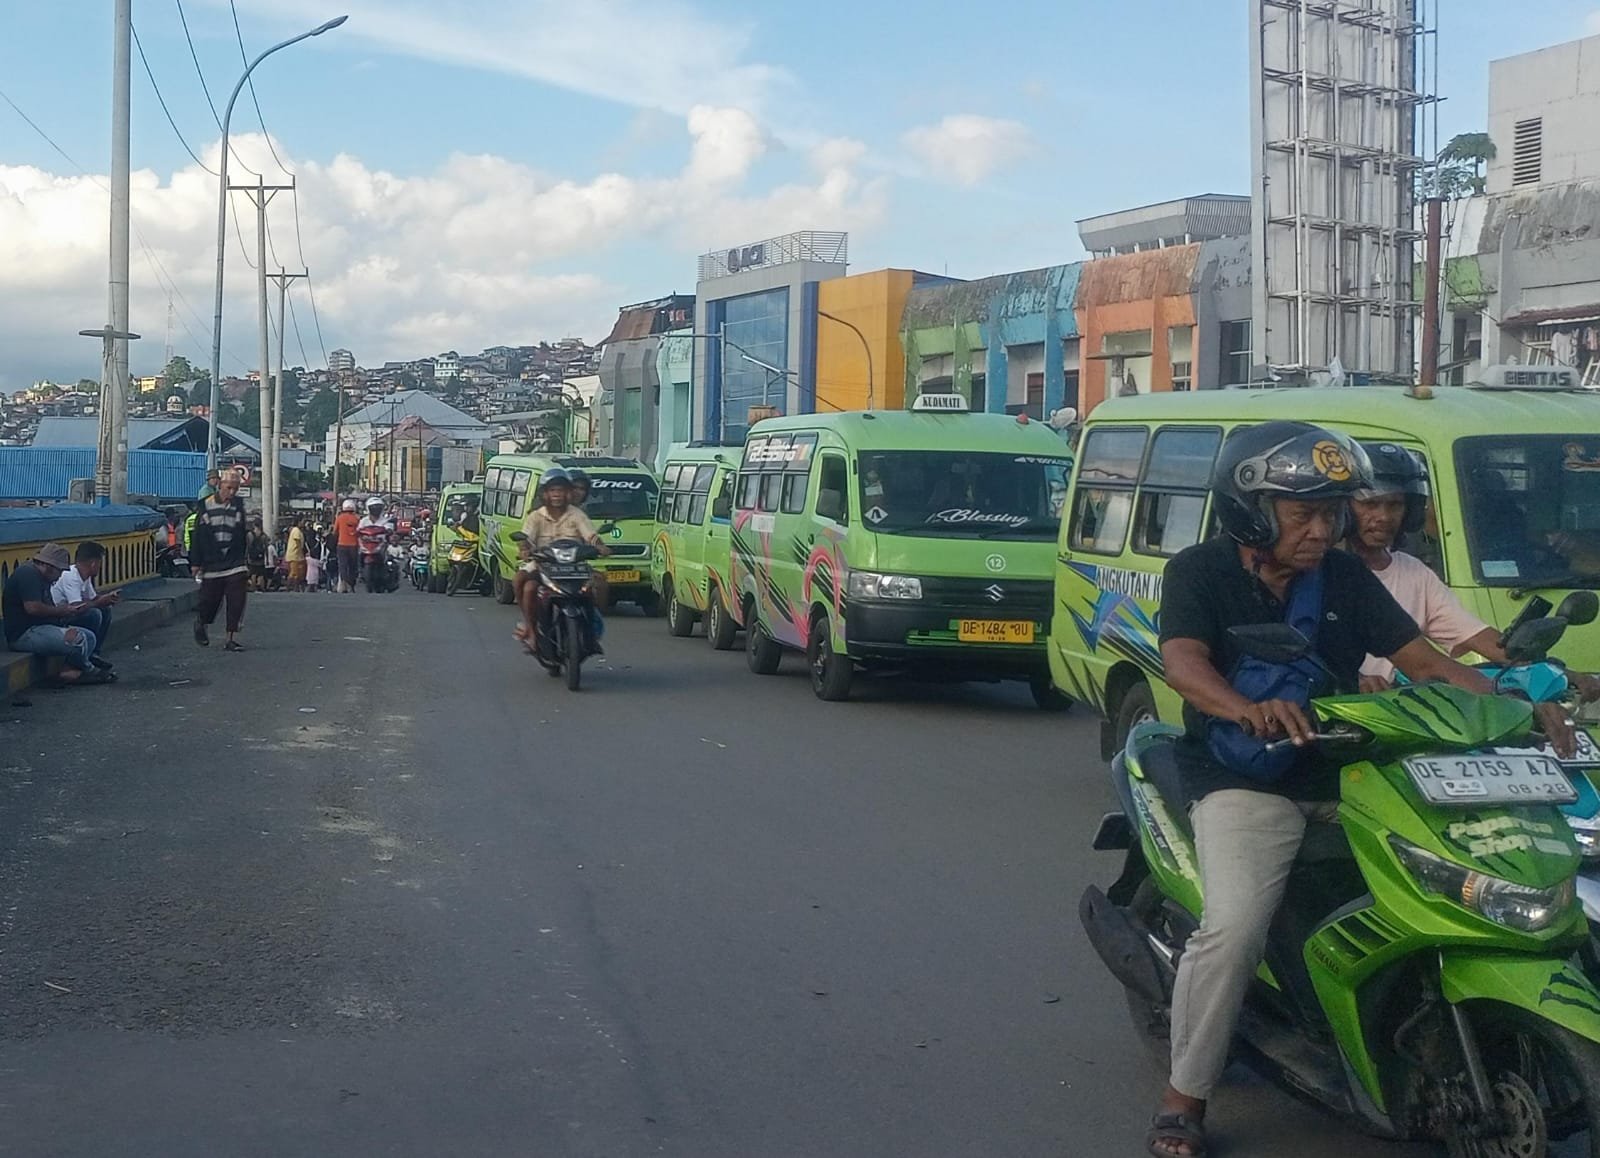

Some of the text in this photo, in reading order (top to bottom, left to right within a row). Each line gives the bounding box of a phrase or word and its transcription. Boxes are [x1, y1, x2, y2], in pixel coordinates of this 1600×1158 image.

[922, 396, 960, 408] KUDAMATI
[936, 508, 1030, 528] Blessing
[989, 558, 1002, 568] 12
[1097, 565, 1152, 600] ANGKUTAN
[963, 621, 977, 635] DE
[980, 622, 1007, 636] 1484
[1415, 759, 1556, 779] DE 2759 AZ
